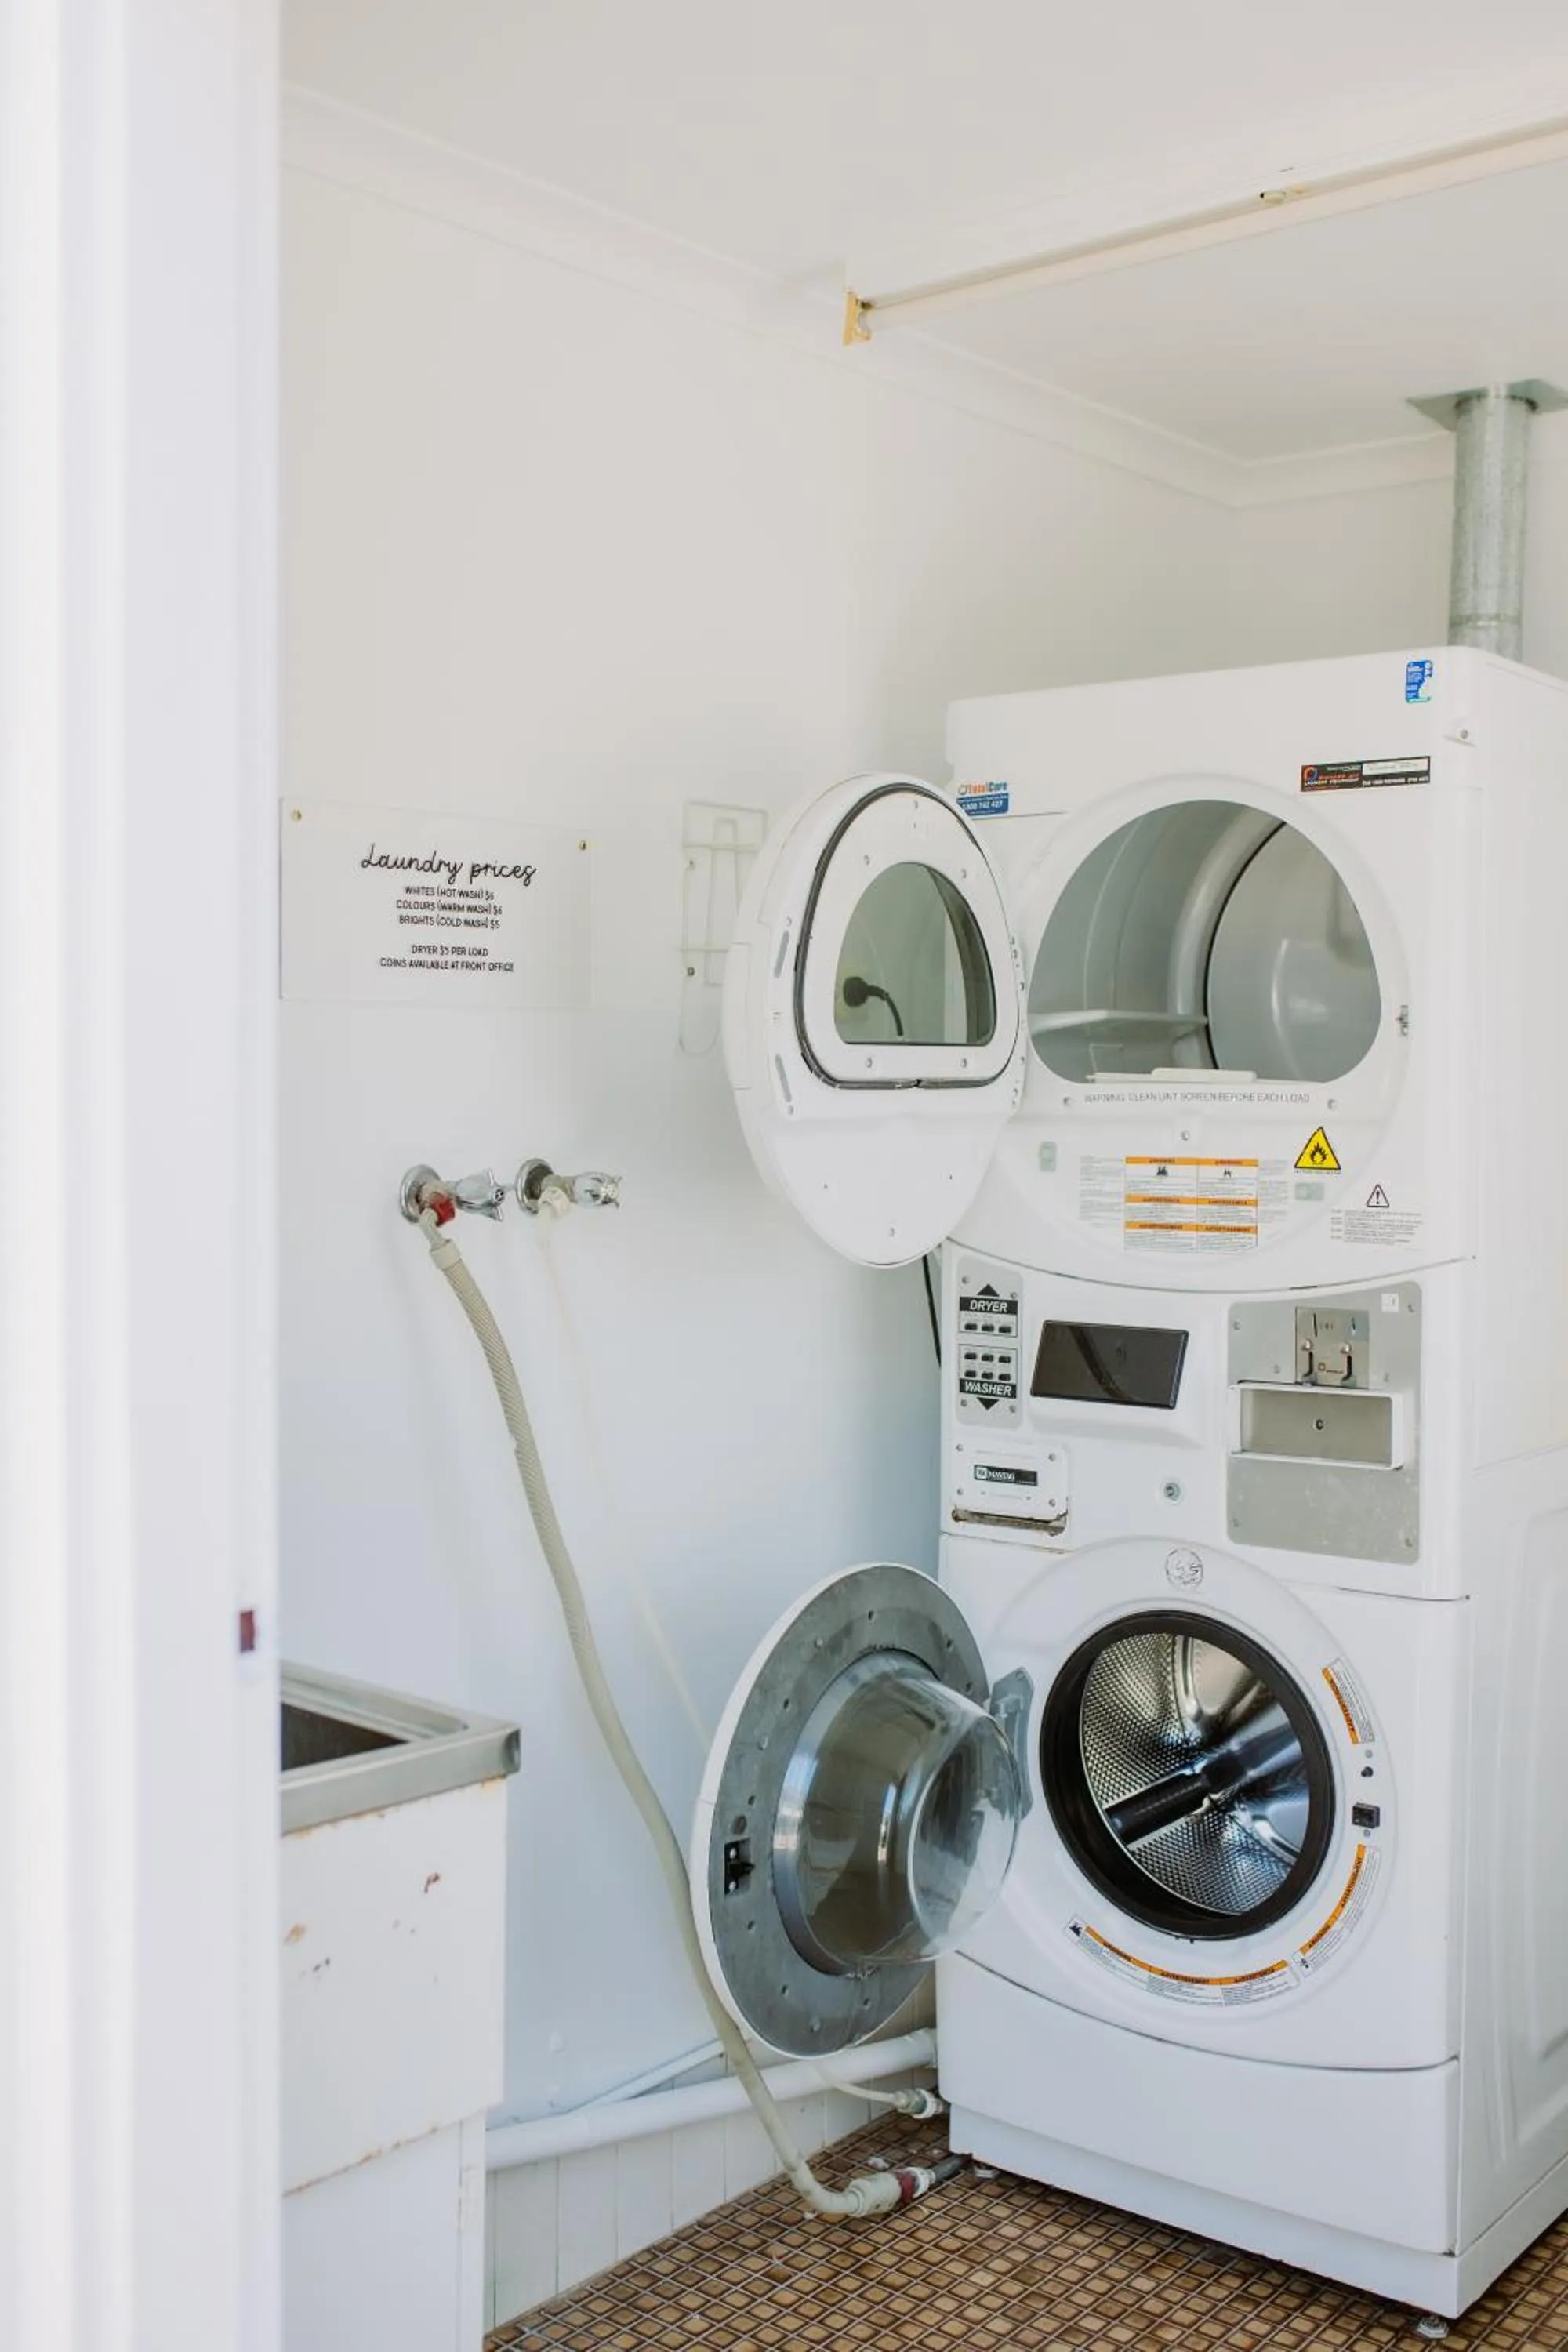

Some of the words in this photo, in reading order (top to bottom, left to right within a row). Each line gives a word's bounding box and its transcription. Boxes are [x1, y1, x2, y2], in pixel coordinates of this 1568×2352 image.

[361, 843, 463, 885] Laundry
[469, 862, 537, 887] prices
[405, 886, 435, 896] WHITES
[396, 899, 436, 910] COLOURS
[399, 914, 435, 926] BRIGHTS
[412, 944, 437, 955] DRYER
[451, 946, 466, 956] PER
[468, 947, 488, 957] LOAD
[380, 957, 407, 967] COINS
[408, 959, 449, 970] AVAILABLE
[450, 960, 459, 970] AT
[460, 960, 486, 971] FRONT
[488, 962, 514, 972] OFFICE
[1128, 1092, 1157, 1102] CLEAN
[1179, 1092, 1217, 1102] SCREEN
[1218, 1092, 1254, 1102] BEFORE
[969, 1299, 1008, 1312] DRYER
[964, 1381, 1012, 1396] WASHER
